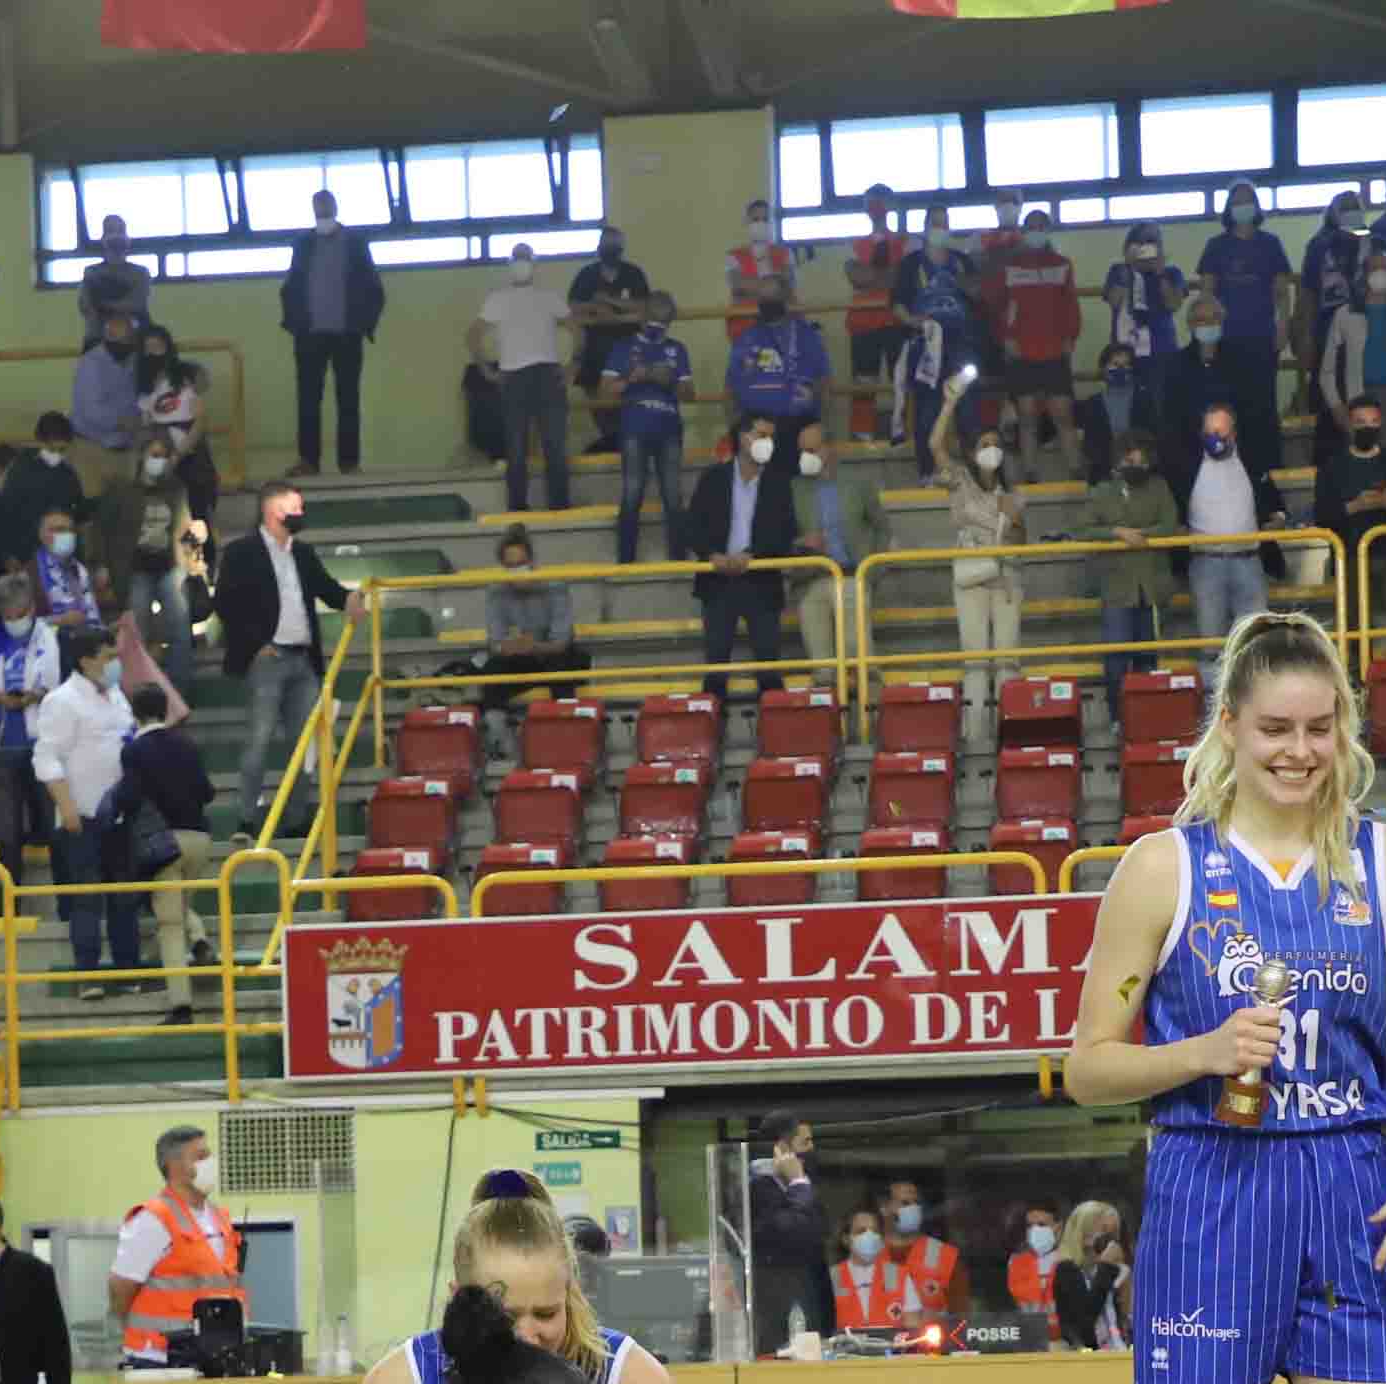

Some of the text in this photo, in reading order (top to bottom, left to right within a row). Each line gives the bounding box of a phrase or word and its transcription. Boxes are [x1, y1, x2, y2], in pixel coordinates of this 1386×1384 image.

[433, 994, 886, 1064] PATRIMONIO
[909, 990, 1025, 1048] DE
[1277, 1008, 1320, 1071] 31
[1269, 1079, 1366, 1120] YRSA
[966, 1326, 1021, 1342] POSSE
